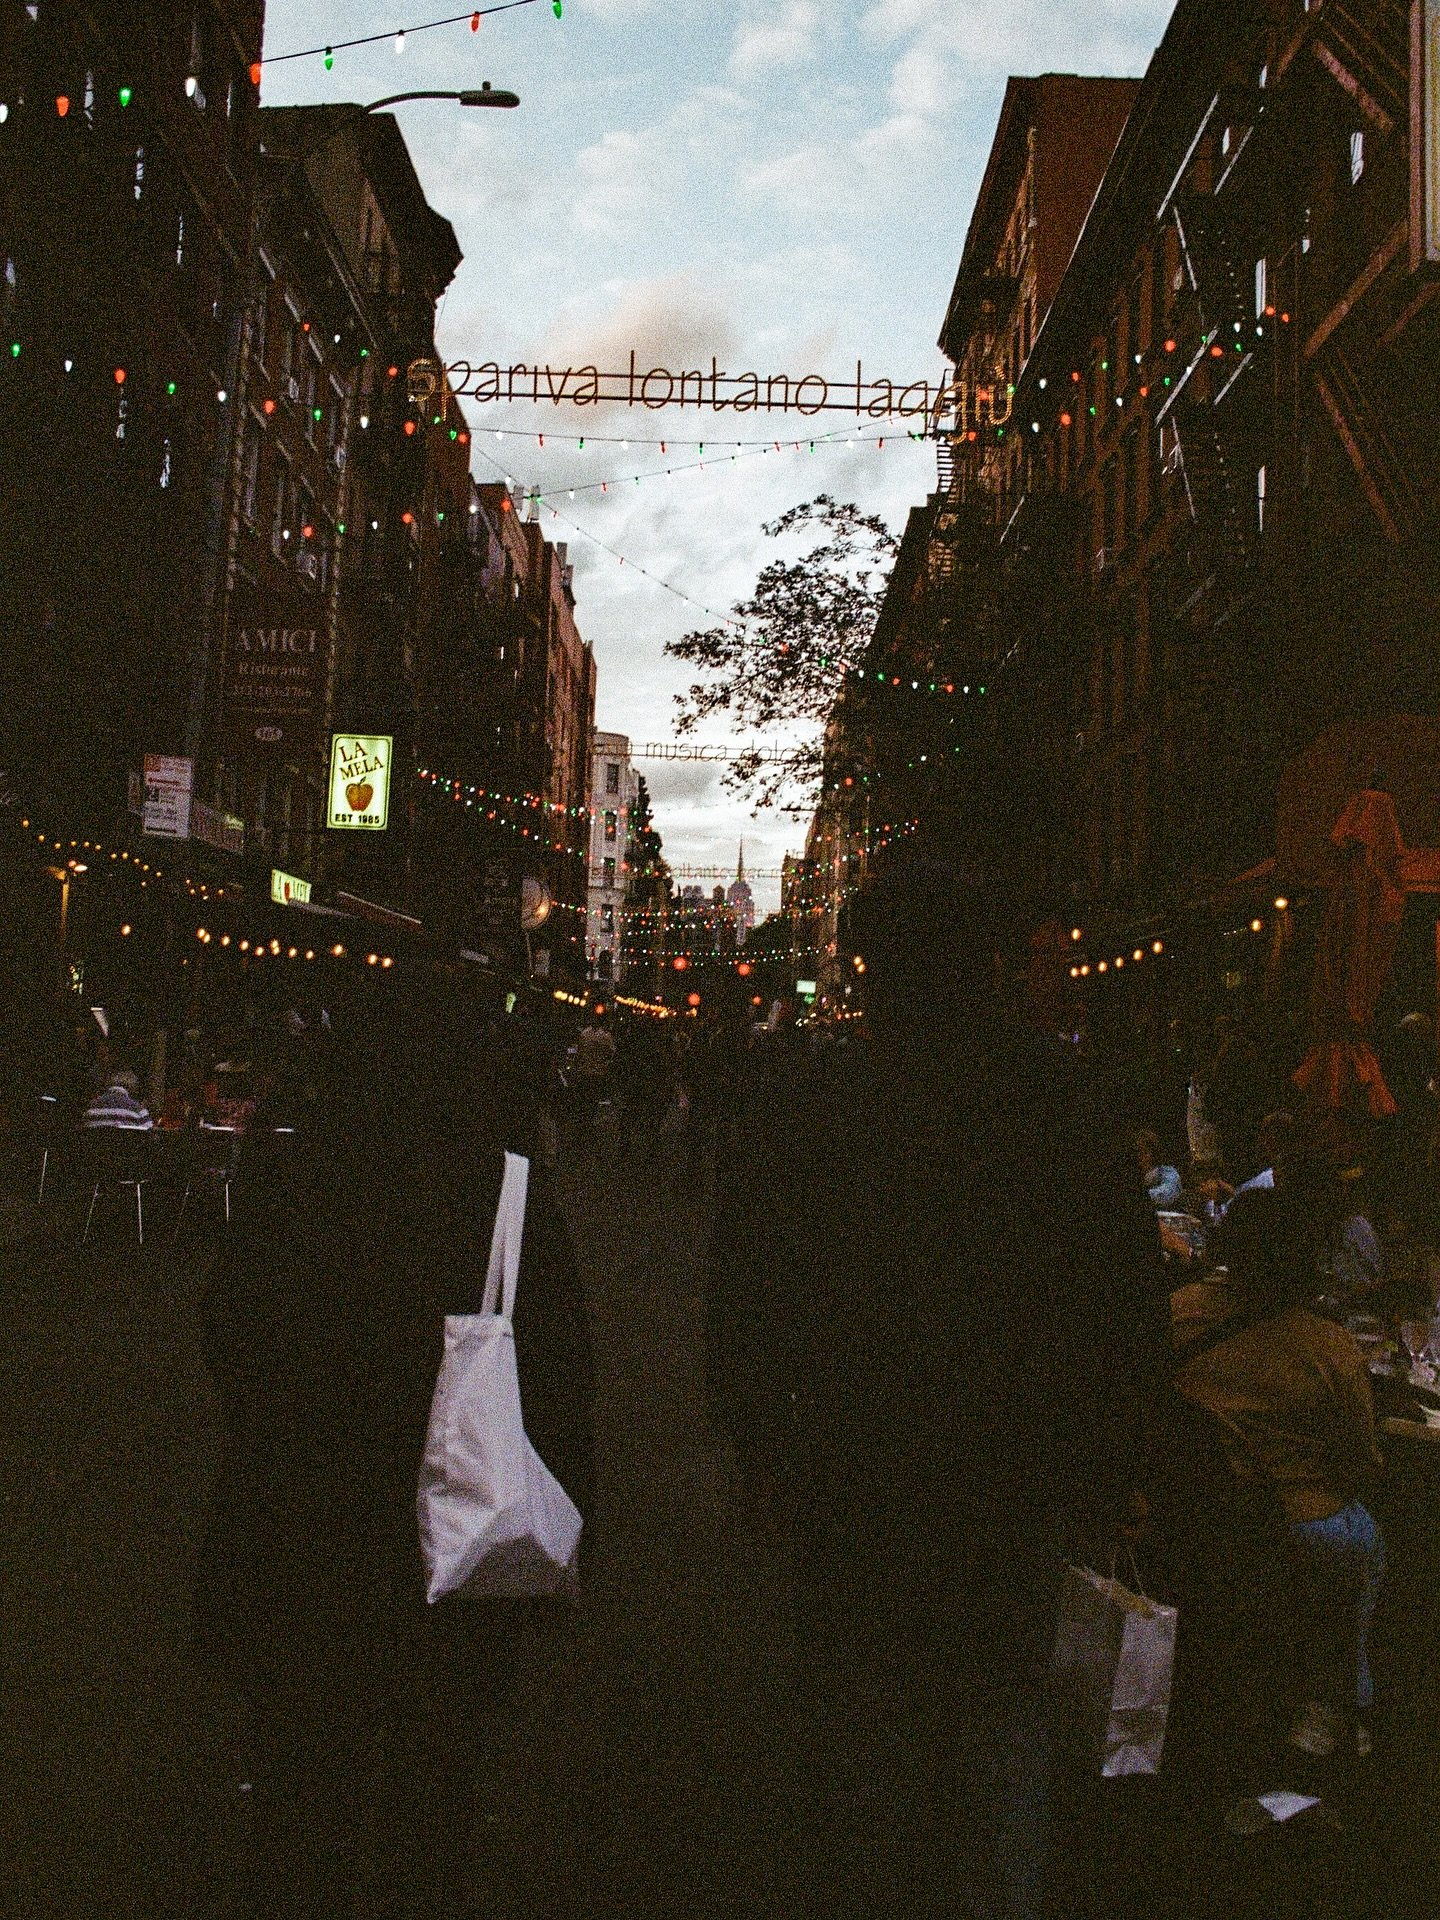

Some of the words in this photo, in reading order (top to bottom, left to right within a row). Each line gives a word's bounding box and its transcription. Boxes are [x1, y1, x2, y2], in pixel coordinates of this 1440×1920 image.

[407, 358, 599, 422] spariva
[629, 349, 829, 417] lontano
[234, 628, 317, 653] AMICI
[339, 741, 368, 763] LA
[646, 742, 728, 761] musica
[339, 755, 384, 780] MELA
[335, 813, 353, 823] EST
[358, 814, 380, 824] 1985
